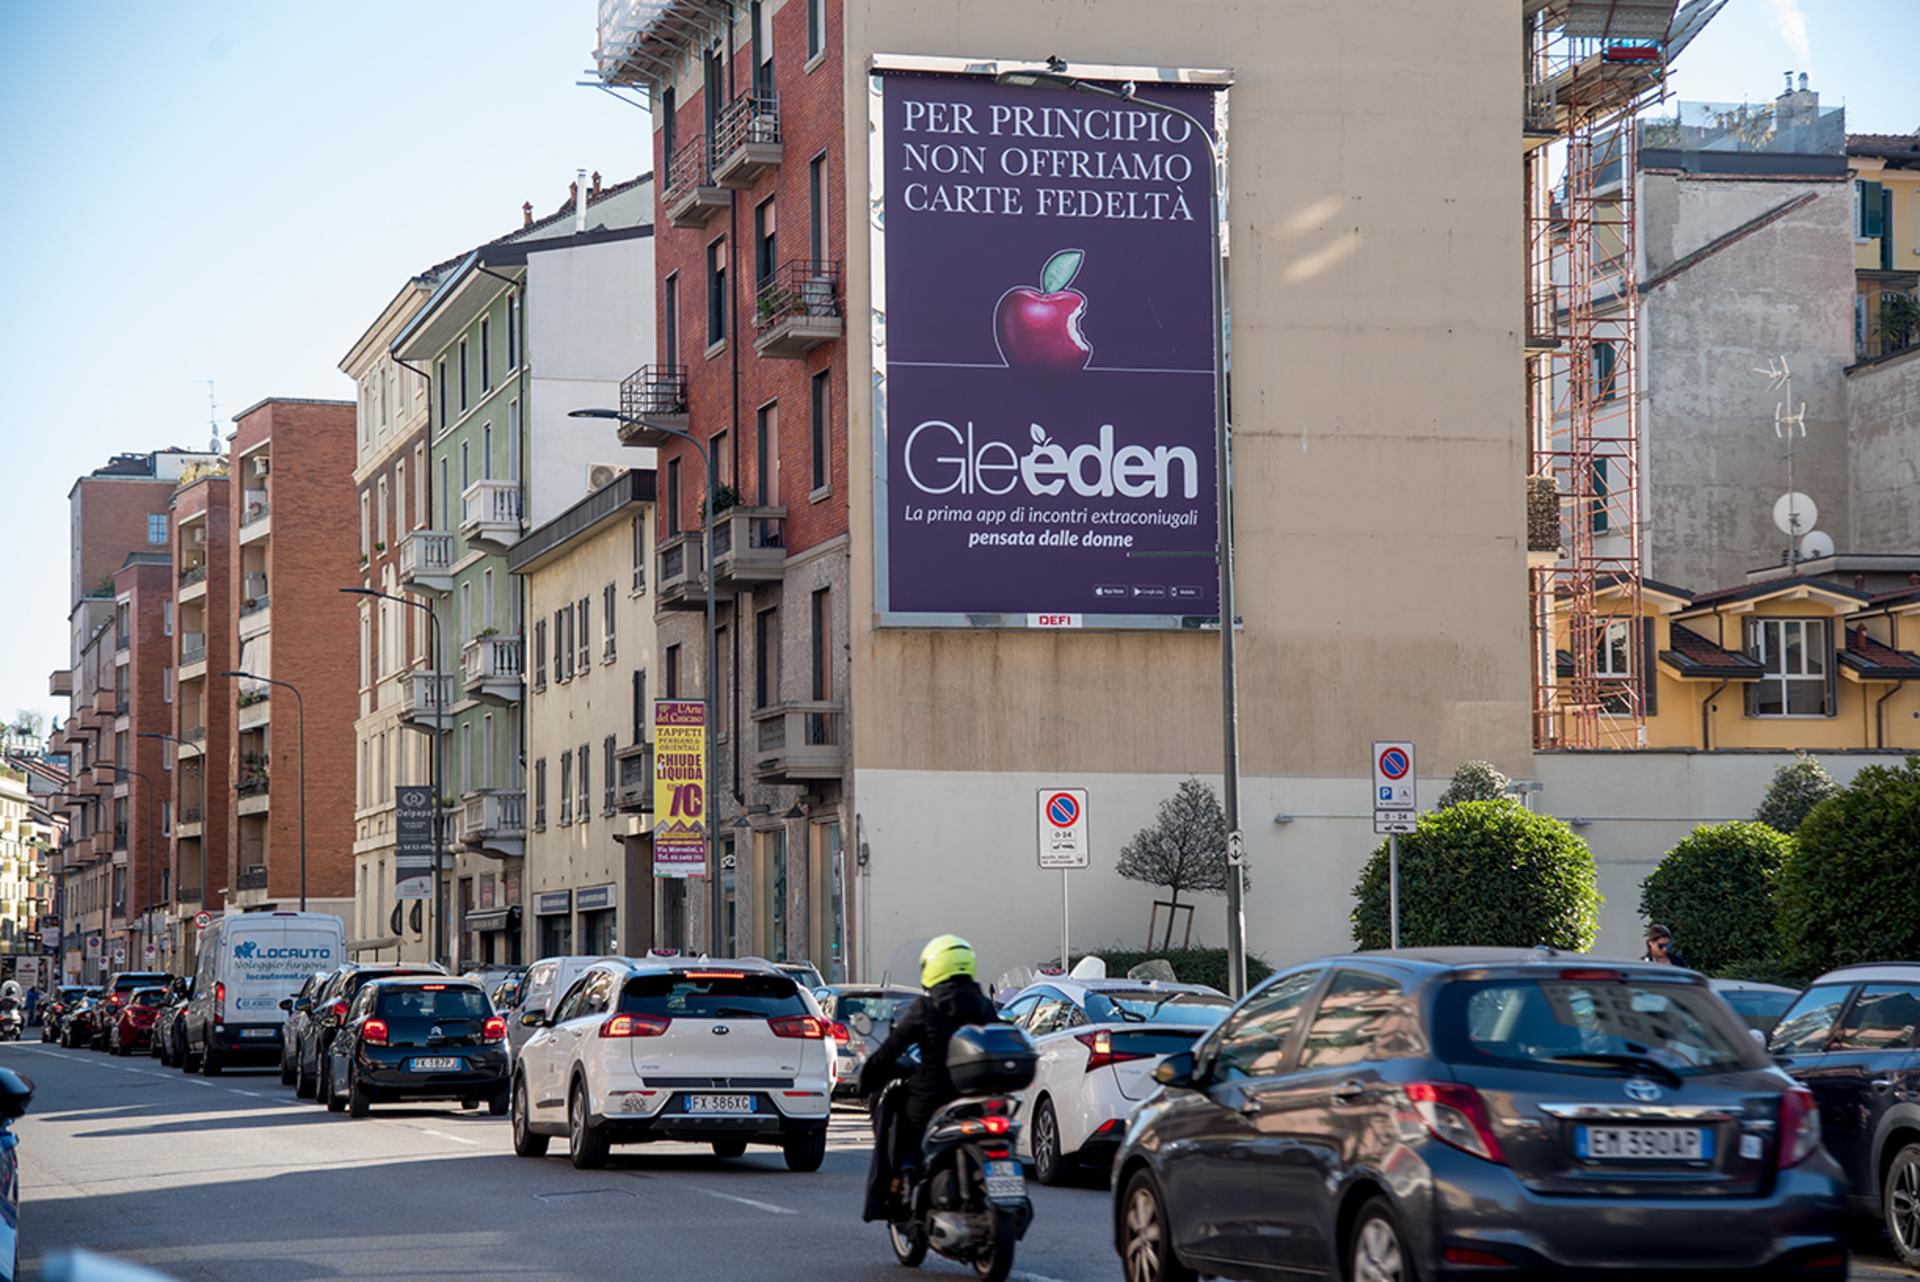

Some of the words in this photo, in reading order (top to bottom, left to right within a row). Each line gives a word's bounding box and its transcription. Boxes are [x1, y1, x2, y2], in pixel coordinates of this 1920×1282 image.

[902, 100, 979, 135] PER
[989, 104, 1192, 144] PRINCIPIO
[902, 143, 987, 174] NON
[1000, 147, 1193, 183] OFFRIAMO
[903, 183, 1024, 216] CARTE
[1036, 185, 1195, 221] FEDELTÀ
[904, 420, 1199, 499] Gleeden
[905, 505, 923, 521] La
[927, 506, 972, 525] prima
[976, 509, 1006, 525] app
[1010, 505, 1025, 523] di
[1028, 507, 1088, 524] incontri
[1091, 509, 1199, 528] extraconiugali
[968, 530, 1035, 548] pensata
[1038, 530, 1079, 547] dalle
[1082, 530, 1134, 547] donne
[1039, 615, 1071, 625] DEFI
[657, 728, 702, 736] TAPPETI
[657, 753, 702, 766] CHIUDE
[657, 766, 703, 781] LIQUIDA
[257, 948, 330, 959] LOCAUTO
[233, 960, 283, 971] Noleggio
[285, 960, 328, 971] furgoni
[692, 1096, 707, 1109] FX
[1591, 1129, 1621, 1155] EM
[1628, 1129, 1698, 1155] 390AP
